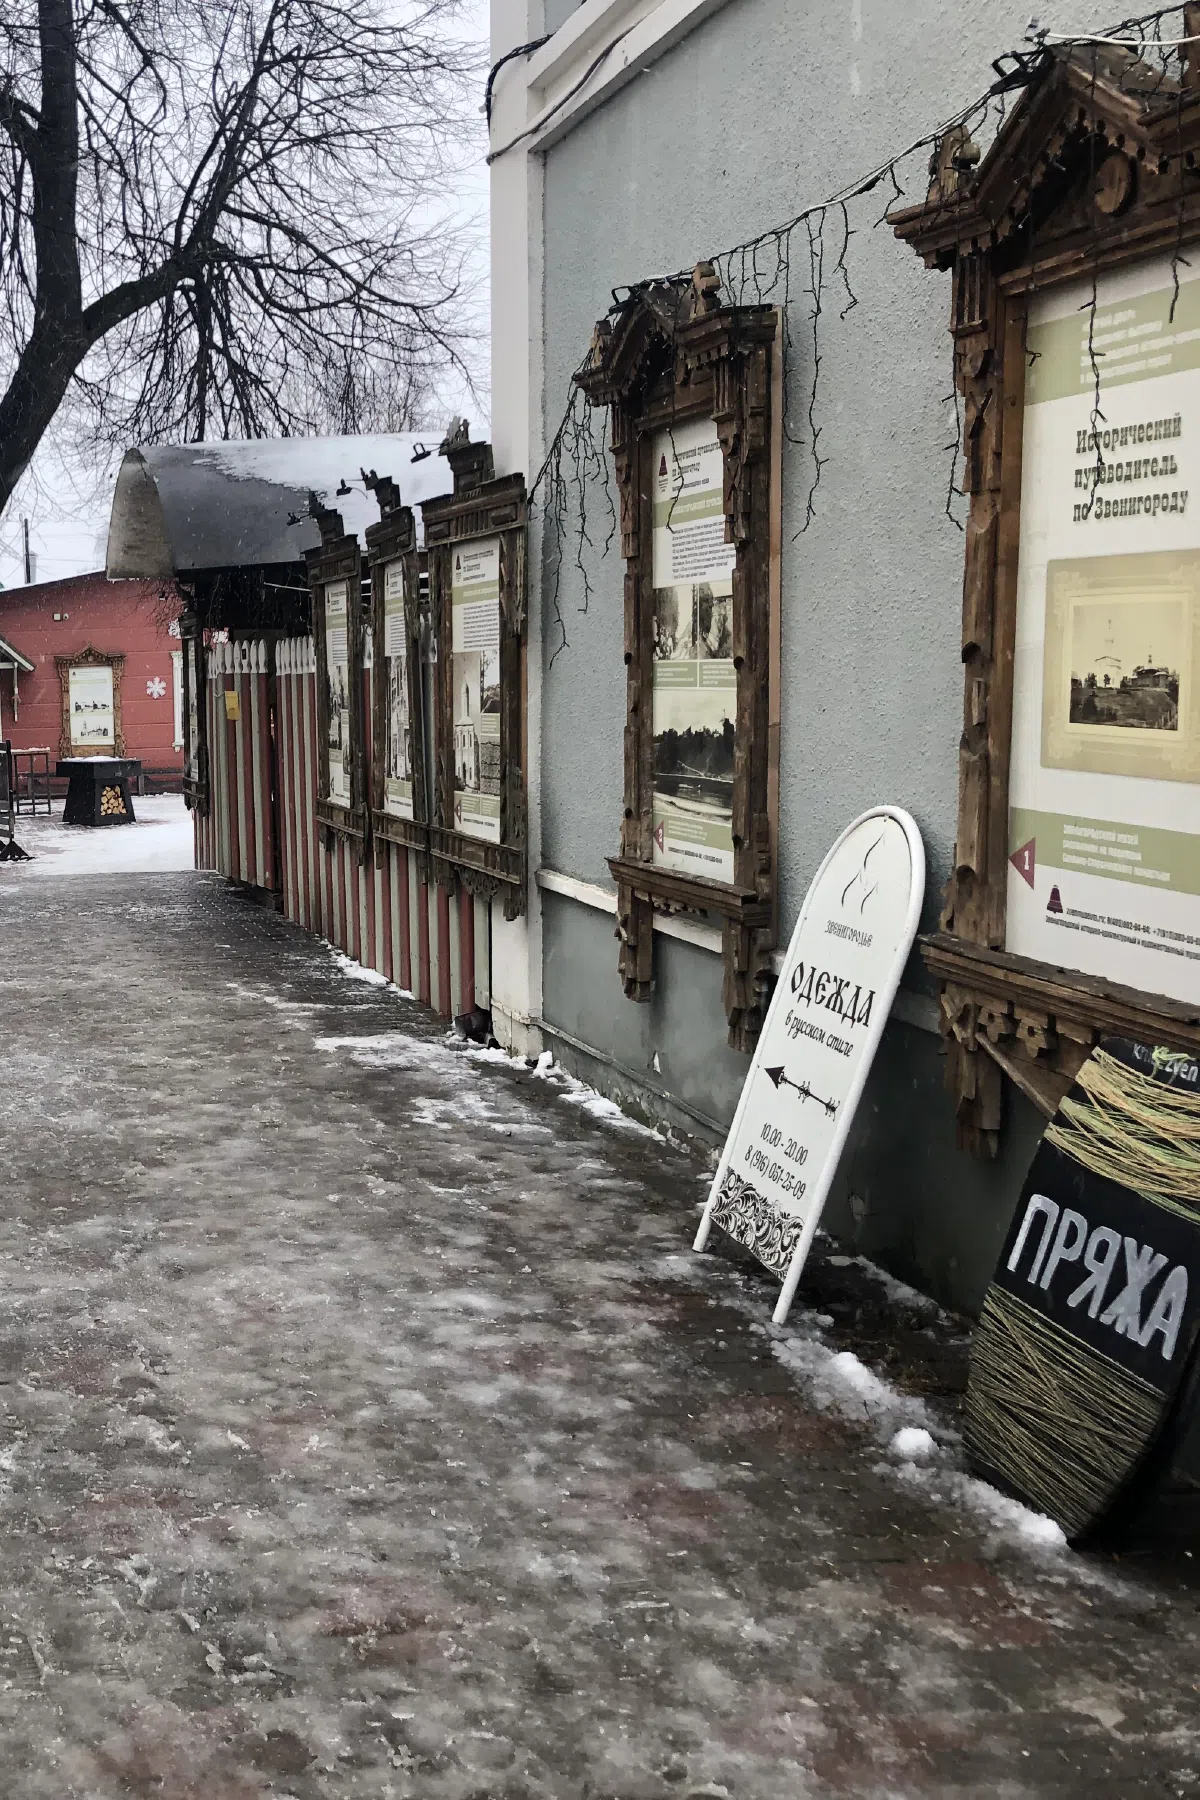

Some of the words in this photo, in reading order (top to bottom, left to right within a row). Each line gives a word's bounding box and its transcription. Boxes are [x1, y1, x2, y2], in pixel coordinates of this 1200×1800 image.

[1076, 411, 1182, 454] Исторический
[1074, 454, 1178, 490] путеводитель
[1073, 501, 1092, 522] по
[1094, 490, 1189, 520] Звенигороду
[1023, 850, 1030, 871] 1
[790, 961, 876, 1029] ОДЕЖДА
[785, 1009, 794, 1026] в
[787, 1017, 826, 1044] русском
[825, 1033, 854, 1058] стиле
[760, 1122, 783, 1147] 10.00
[784, 1138, 809, 1166] 20.00
[744, 1144, 753, 1161] 8
[750, 1149, 771, 1178] (916)
[768, 1162, 806, 1200] 051-25-09
[1006, 1193, 1189, 1360] ПРЯЖА
